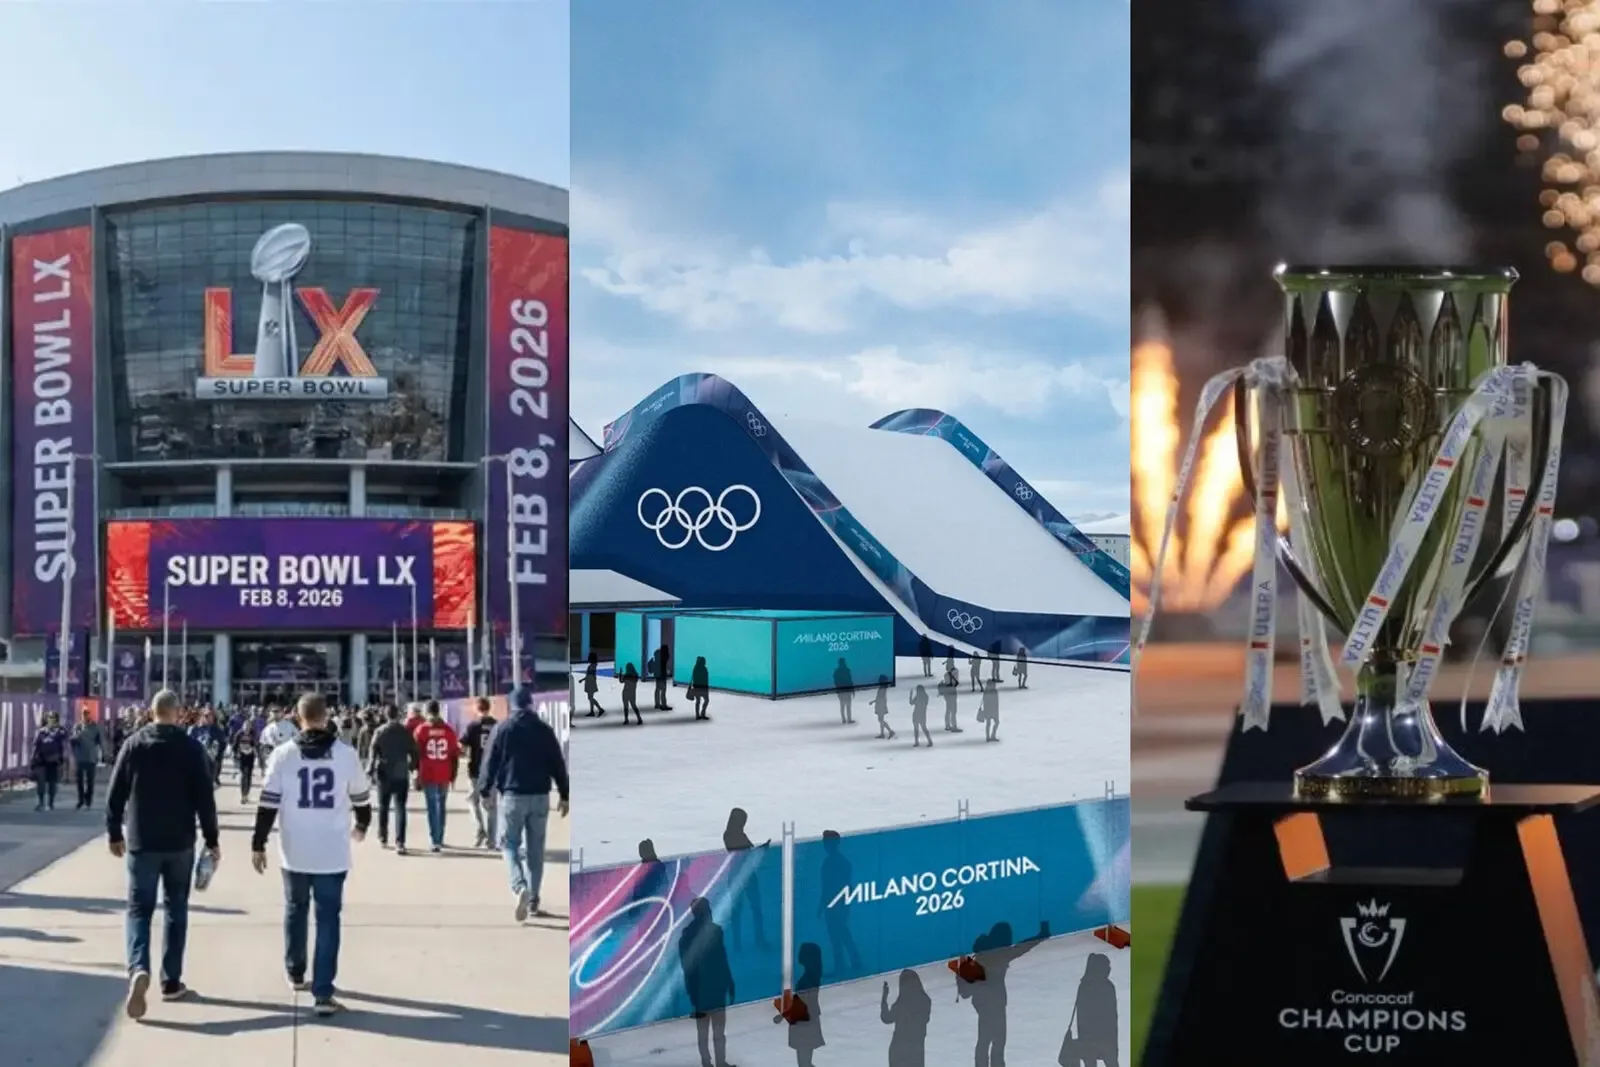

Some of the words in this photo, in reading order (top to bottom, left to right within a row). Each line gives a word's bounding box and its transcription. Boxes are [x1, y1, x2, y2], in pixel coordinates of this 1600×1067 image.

[33, 253, 71, 303] LX
[33, 309, 72, 426] BOWL
[509, 298, 549, 419] 2026
[214, 381, 292, 395] SUPER
[303, 381, 371, 395] BOWL
[510, 433, 556, 479] 8,
[34, 436, 76, 583] SUPER
[1411, 471, 1445, 523] ULTRA
[509, 494, 548, 584] FEB
[1451, 510, 1479, 566] ULTRA
[167, 555, 269, 587] SUPER
[279, 555, 369, 586] BOWL
[378, 555, 416, 586] LX
[240, 589, 272, 606] FEB
[276, 589, 294, 609] 8,
[297, 589, 343, 607] 2026
[1255, 580, 1271, 637] ULTRA
[793, 632, 837, 644] MILANO
[838, 630, 882, 641] CORTINA
[828, 641, 850, 652] 2026
[1345, 607, 1380, 663] ULTRA
[426, 738, 449, 760] 92
[297, 767, 335, 809] 12
[827, 872, 937, 909] MILANO
[941, 856, 1041, 888] CORTINA
[915, 889, 966, 916] 2026
[1331, 989, 1415, 1005] Concacaf
[1278, 1008, 1467, 1031] CHAMPIONS
[1344, 1034, 1401, 1053] CUP
